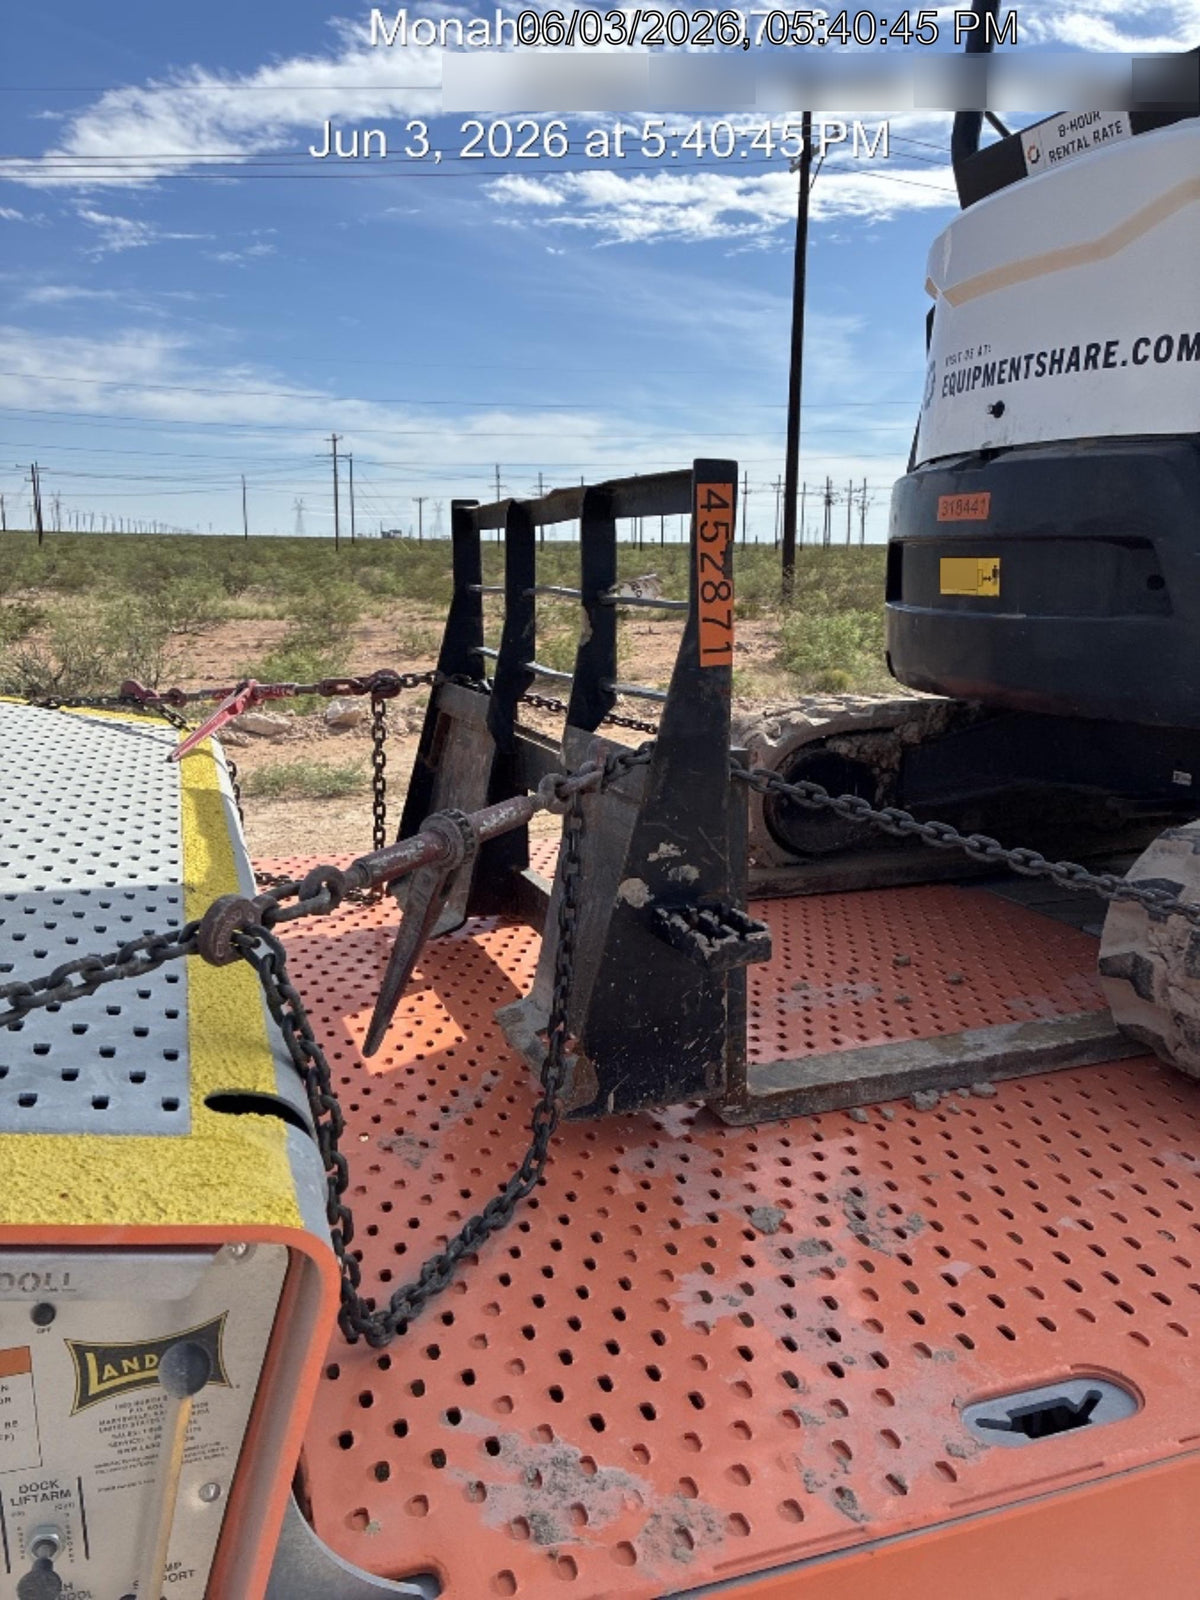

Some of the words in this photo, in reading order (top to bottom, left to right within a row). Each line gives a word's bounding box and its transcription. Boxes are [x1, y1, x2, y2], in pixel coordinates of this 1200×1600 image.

[1048, 136, 1090, 164] RENTAL
[1092, 121, 1123, 144] RATE
[1058, 110, 1101, 137] 8-HOUR
[941, 332, 1200, 398] EQUIPMENTSHARE.COM
[700, 489, 732, 654] 452871
[85, 1352, 158, 1396] LAND
[10, 1488, 72, 1507] LIFTARM
[19, 1479, 60, 1494] DOCK
